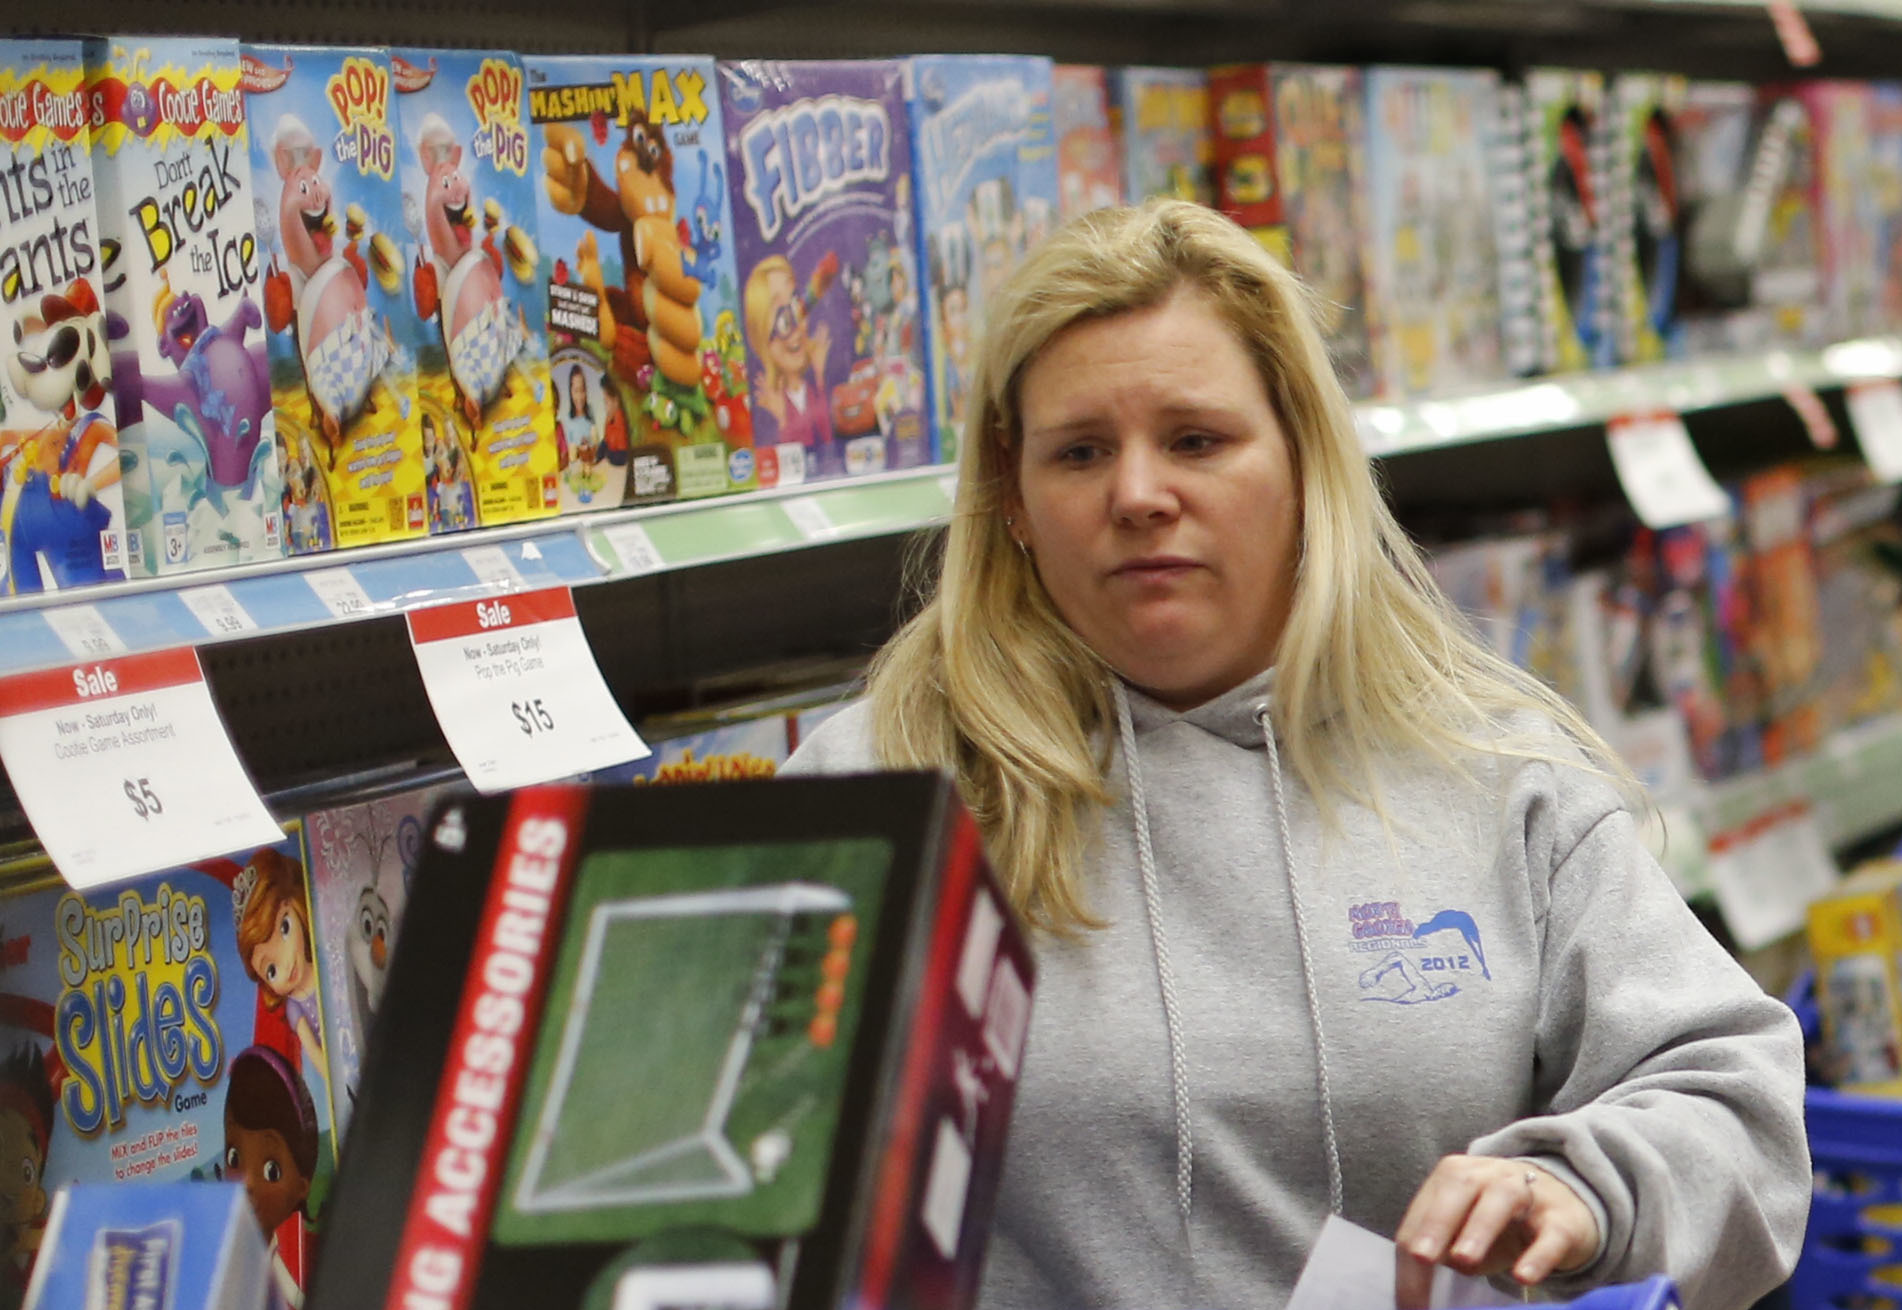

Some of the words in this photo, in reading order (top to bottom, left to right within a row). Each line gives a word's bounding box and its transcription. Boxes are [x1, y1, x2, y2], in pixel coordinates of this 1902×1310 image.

[32, 81, 84, 127] Games
[158, 81, 200, 126] Cootie
[202, 79, 243, 125] Games
[332, 65, 386, 127] POP!
[470, 66, 519, 125] POP!
[530, 86, 617, 121] MASHIN'
[611, 67, 709, 128] MAX
[336, 137, 358, 162] the
[474, 136, 495, 160] the
[154, 150, 194, 190] Don't
[748, 105, 886, 232] FIBBER
[57, 171, 92, 207] the
[130, 135, 241, 274] Break
[191, 244, 212, 273] the
[207, 229, 258, 300] Ice
[170, 538, 183, 558] 3+
[476, 600, 511, 629] Sale
[462, 646, 484, 662] Now
[487, 640, 521, 660] Saturday
[520, 634, 541, 655] Only!
[475, 663, 492, 680] Pop
[506, 659, 521, 678] Pig
[520, 655, 545, 674] Game
[72, 665, 118, 698] Sale
[56, 719, 80, 737] Now
[86, 707, 131, 731] Saturday
[130, 702, 157, 724] Only!
[511, 698, 555, 739] $15
[89, 732, 121, 754] Game
[122, 723, 176, 747] Assortment
[123, 777, 163, 821] $5
[58, 890, 208, 989] Surprise
[1421, 956, 1470, 970] 2012
[57, 952, 222, 1133] Slides
[425, 817, 568, 1238] ACCESSORIES
[174, 1092, 208, 1114] Game
[129, 1137, 150, 1156] and
[165, 1129, 181, 1147] the
[180, 1123, 198, 1144] tiles
[114, 1161, 126, 1179] to
[125, 1153, 157, 1179] change
[157, 1149, 173, 1167] the
[172, 1141, 200, 1165] slides!
